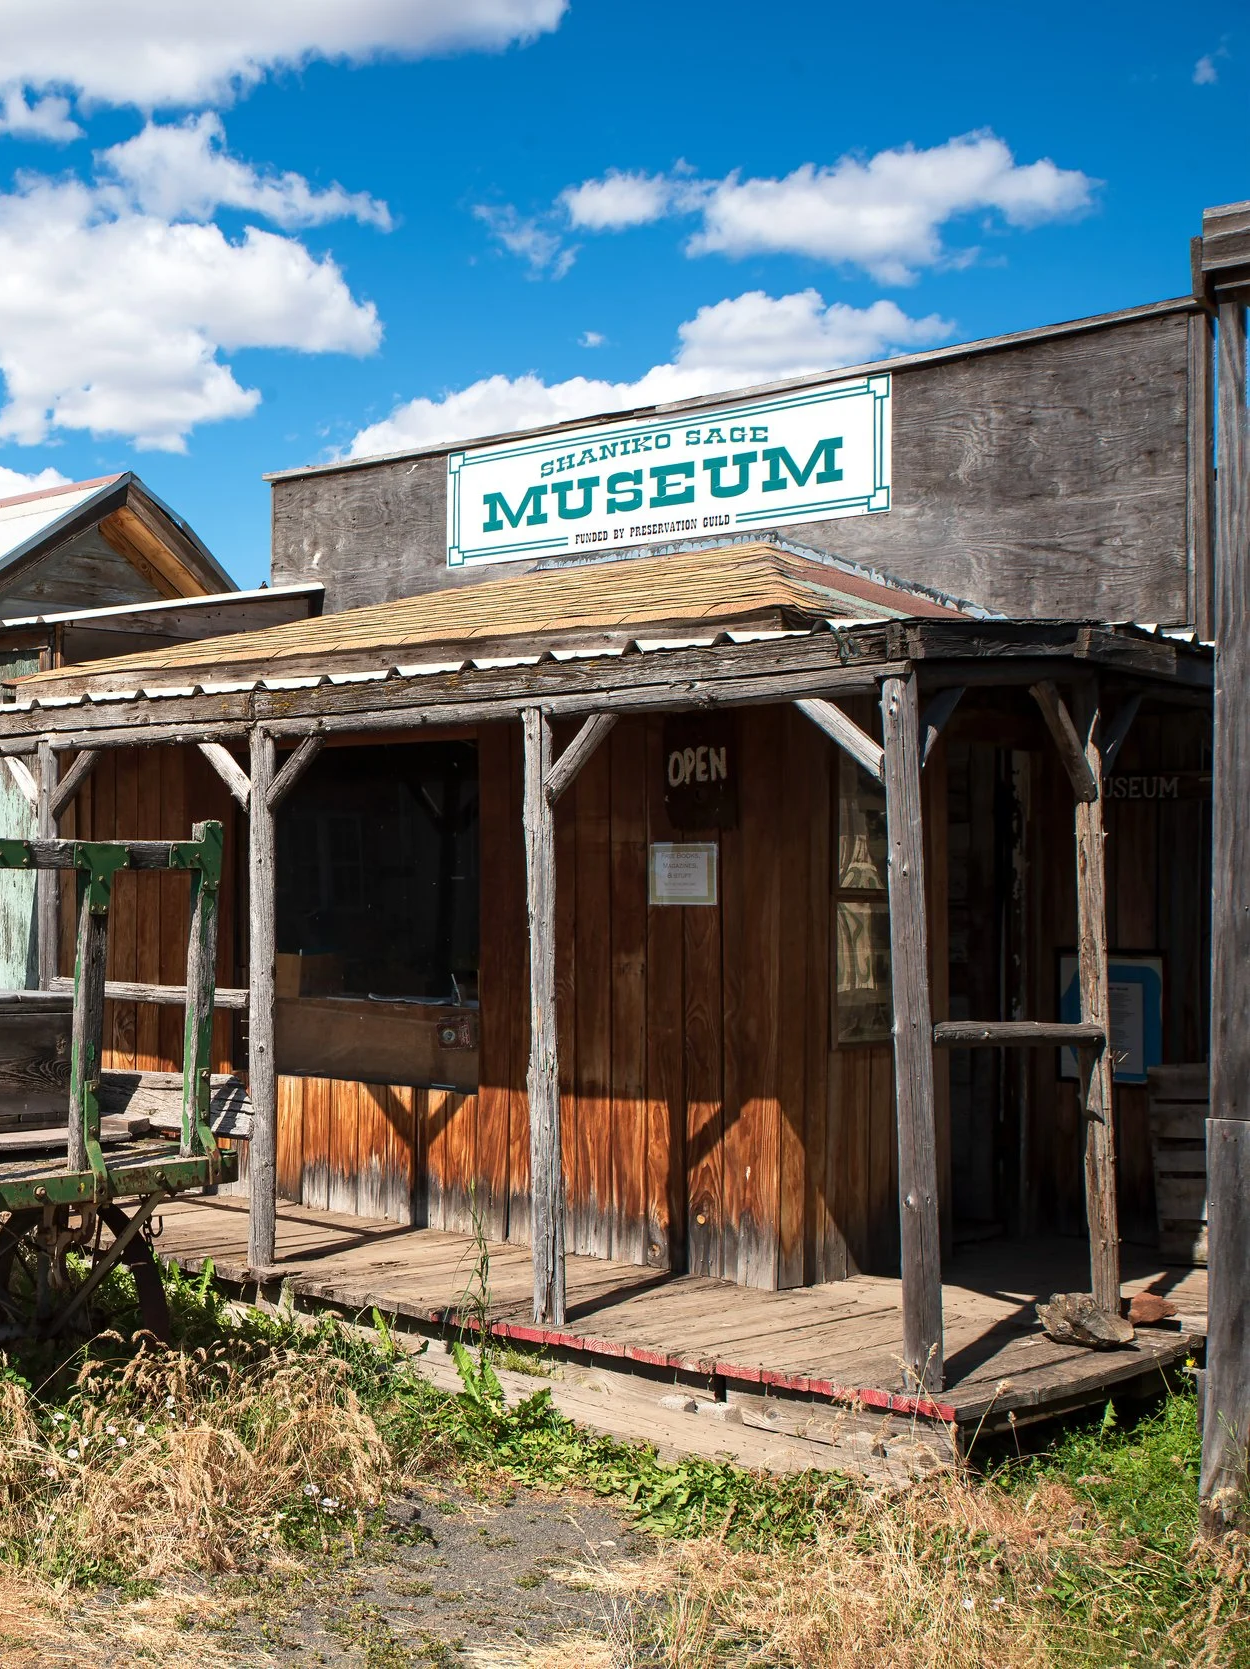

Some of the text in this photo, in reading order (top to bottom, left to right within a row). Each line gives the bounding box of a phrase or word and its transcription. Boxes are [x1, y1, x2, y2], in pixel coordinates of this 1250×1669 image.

[540, 426, 769, 478] SHANIKO SAGE
[482, 436, 844, 533] MUSEUM
[574, 513, 731, 545] FUNDED BY PRESERVATION GUILD
[667, 745, 728, 788] OPEN
[1102, 776, 1180, 798] USEUM
